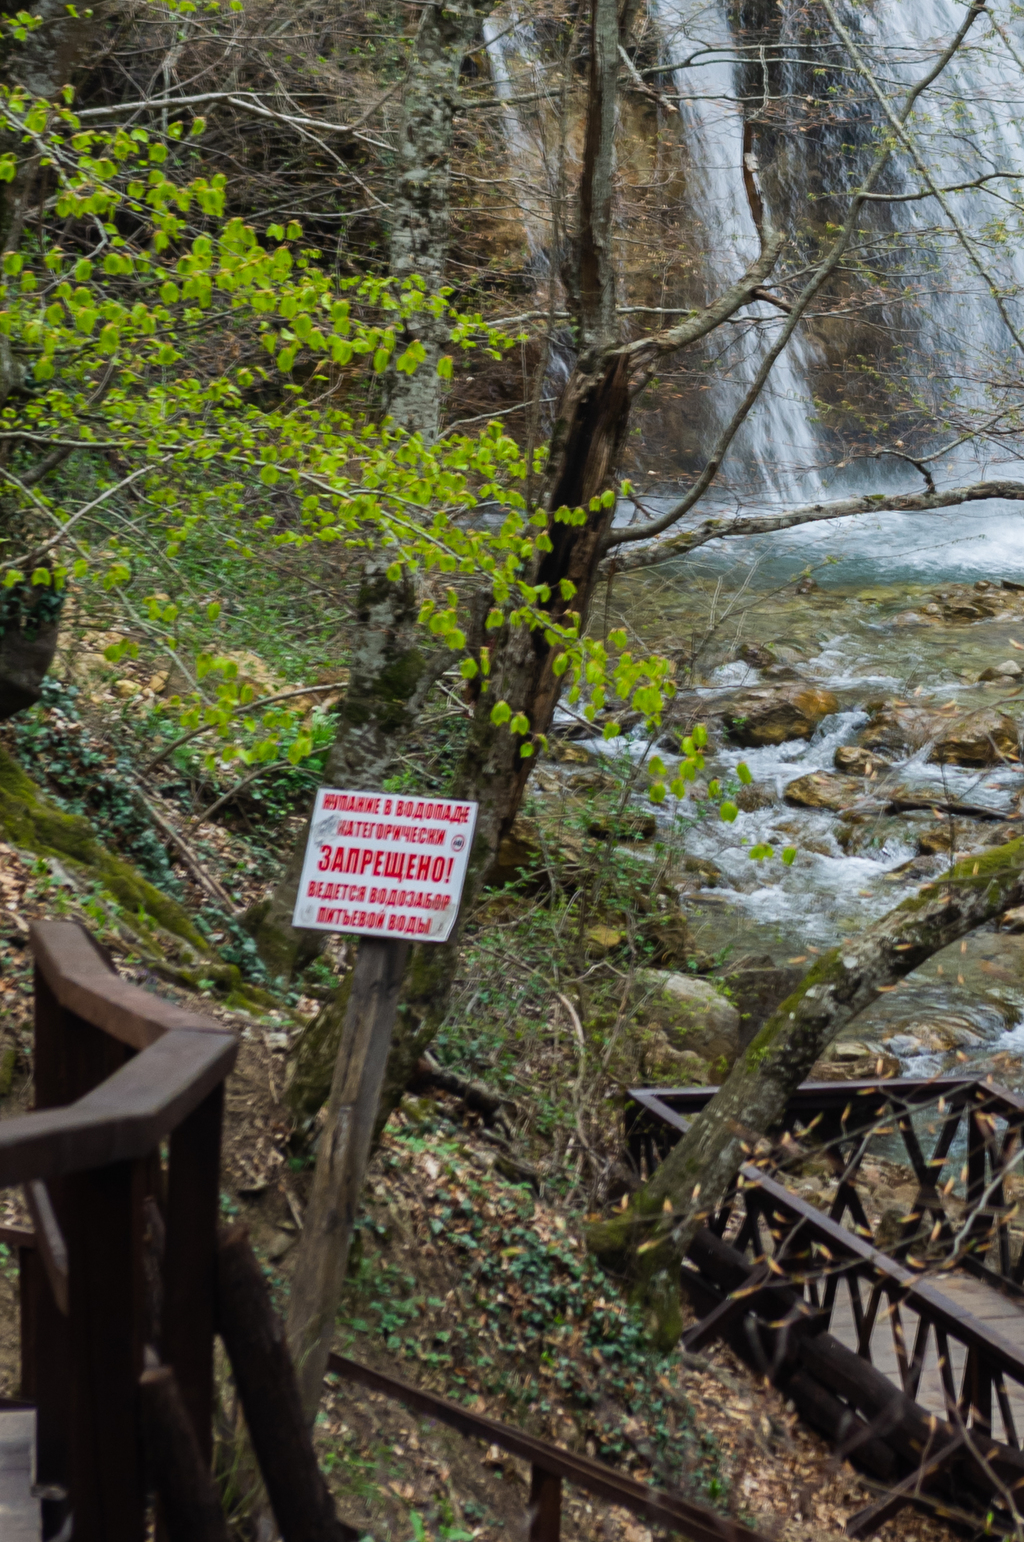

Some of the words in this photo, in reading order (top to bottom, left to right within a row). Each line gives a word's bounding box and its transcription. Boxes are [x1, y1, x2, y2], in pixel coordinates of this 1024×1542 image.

[322, 793, 381, 814] КУПАНИЕ
[383, 799, 393, 816] В
[394, 800, 471, 823] ВОДОПАДЕ
[337, 819, 446, 846] КАТЕГОРИЧЕСКИ
[317, 845, 455, 883] ЗАПРЕЩЕНО!
[306, 880, 367, 903] ВЕДЕТСЯ
[368, 887, 452, 910] ВОДОЗАБОР
[316, 906, 385, 929] ПИТЬЕВОЙ
[387, 914, 432, 934] ВОДЫ
